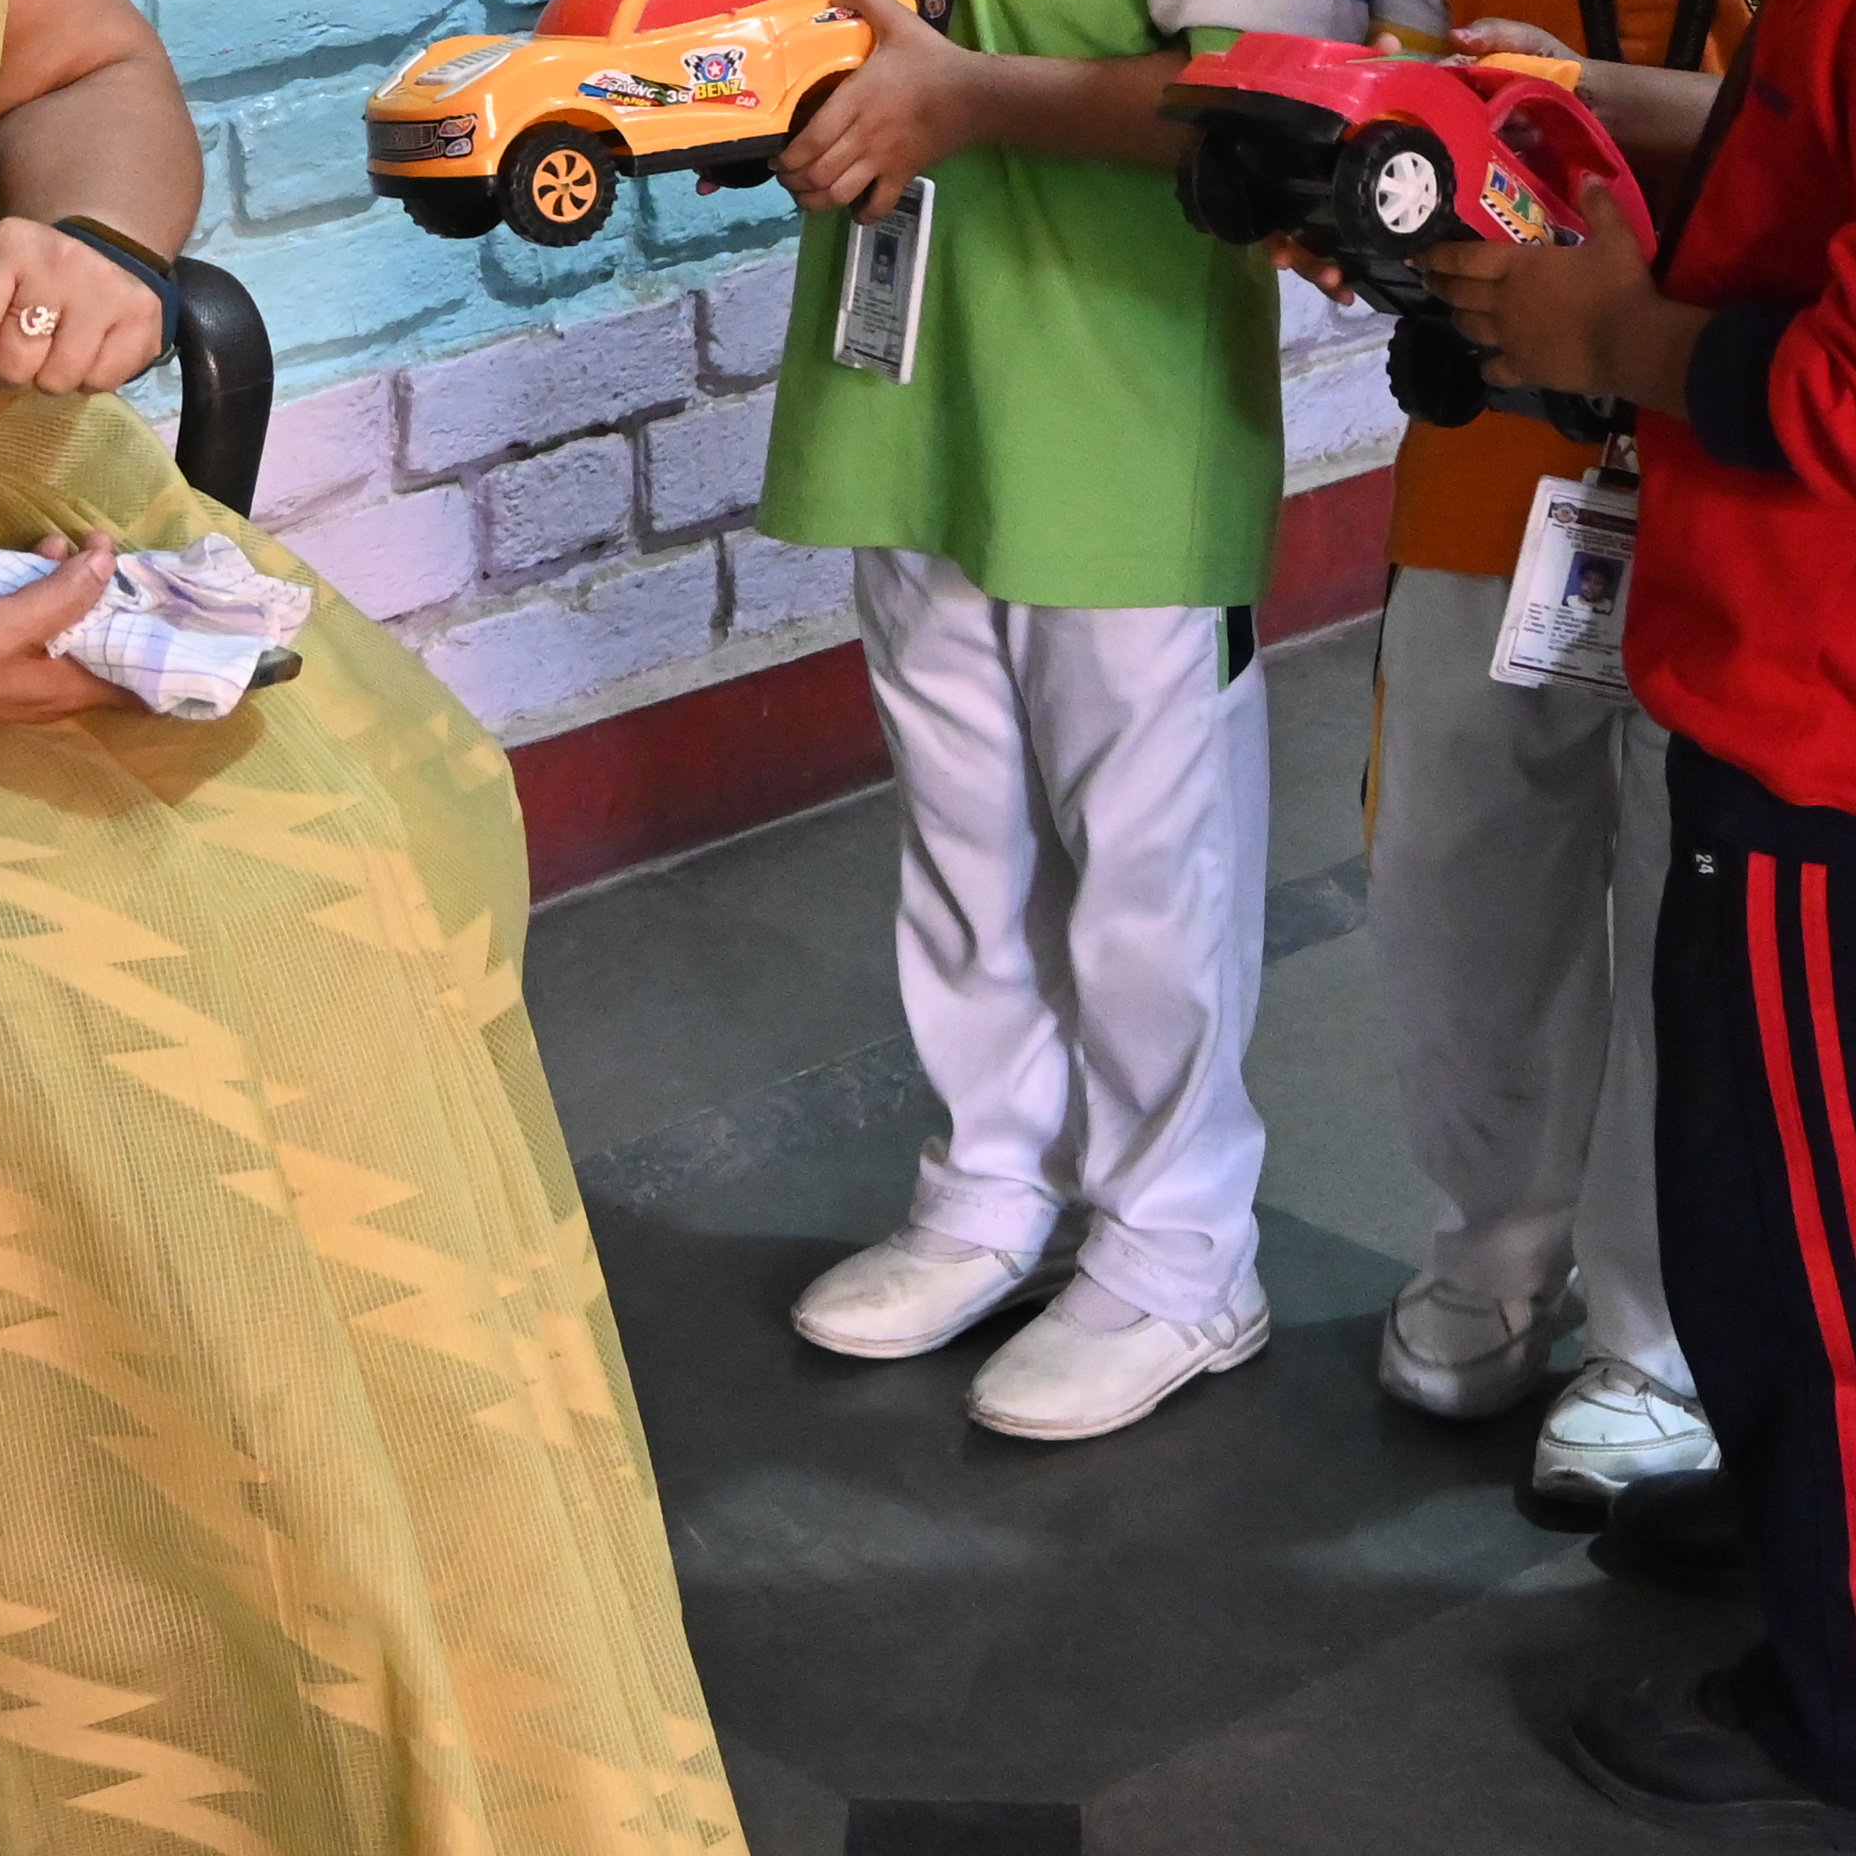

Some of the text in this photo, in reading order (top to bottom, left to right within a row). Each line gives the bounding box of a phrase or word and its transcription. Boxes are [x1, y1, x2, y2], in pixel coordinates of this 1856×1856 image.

[666, 90, 690, 103] 36
[695, 79, 743, 100] BENZ
[736, 95, 757, 107] CAR
[1694, 853, 1715, 874] 24
